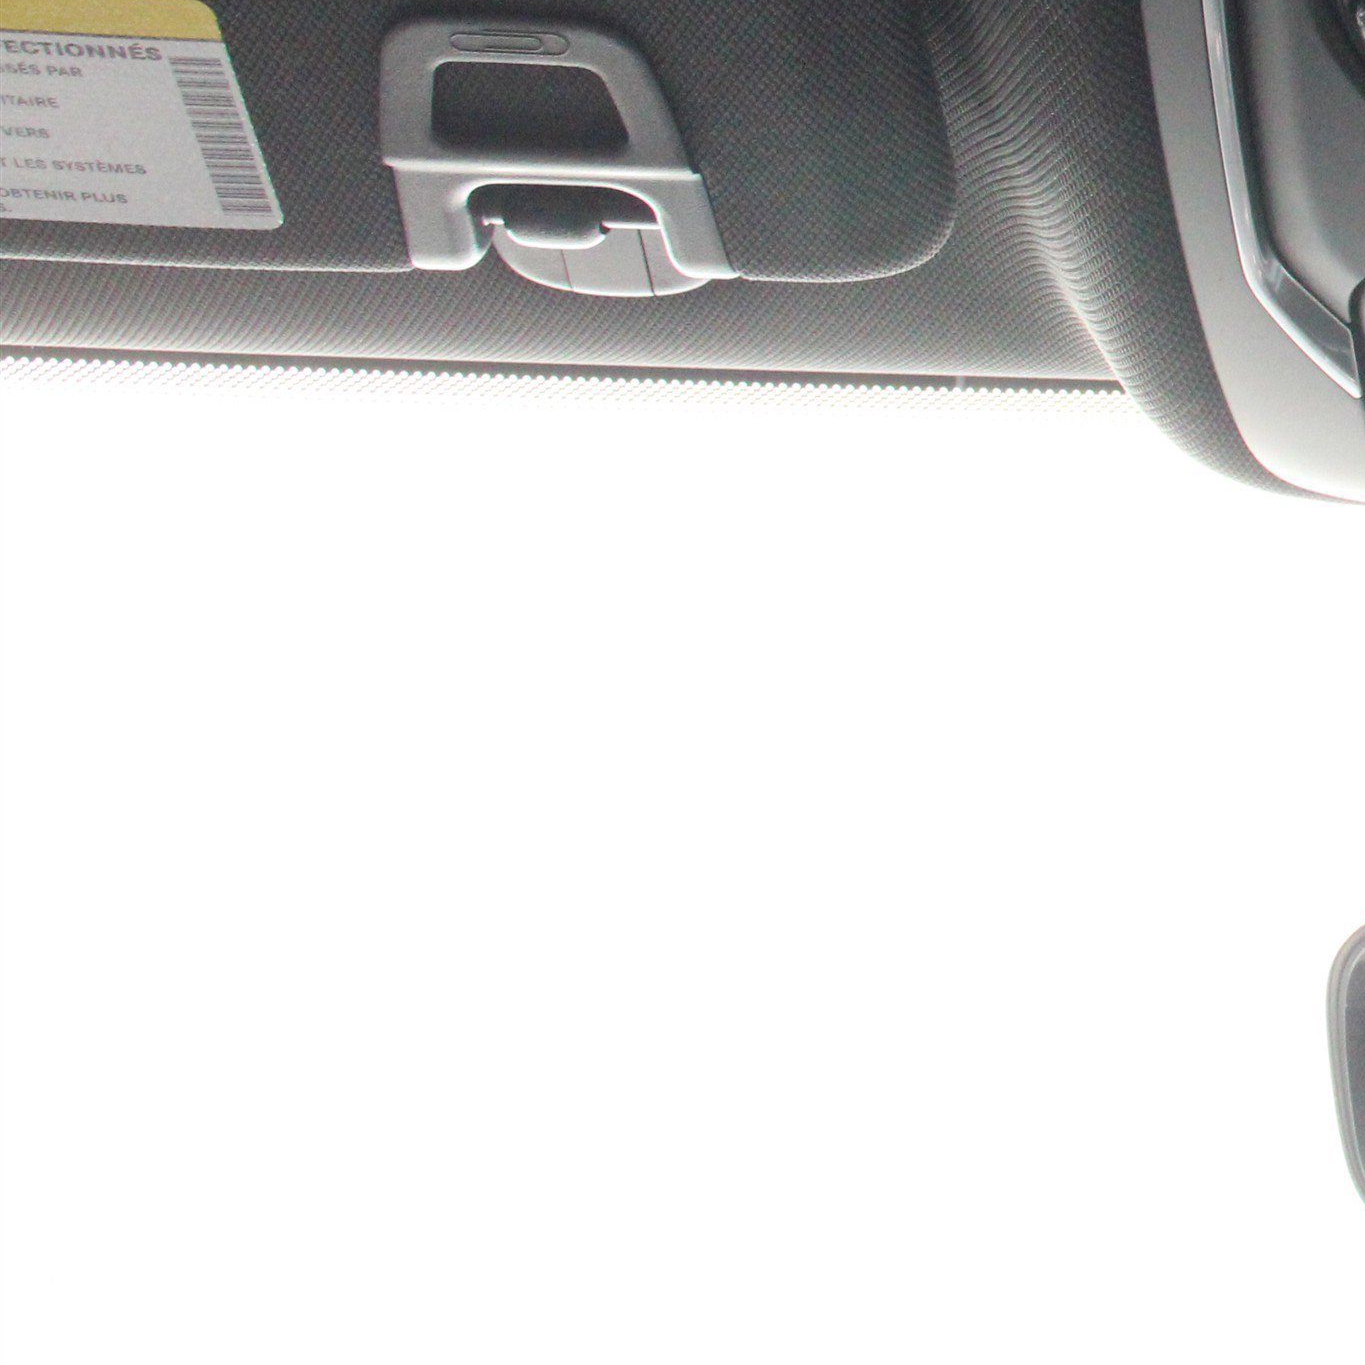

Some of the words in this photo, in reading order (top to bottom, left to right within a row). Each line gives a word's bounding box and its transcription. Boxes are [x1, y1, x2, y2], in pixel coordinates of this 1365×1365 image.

[0, 40, 162, 61] ECTIONNÉS
[46, 65, 83, 77] PAR
[13, 155, 48, 169] LES
[52, 159, 147, 175] SYSTÈMES
[81, 191, 128, 204] PLUS
